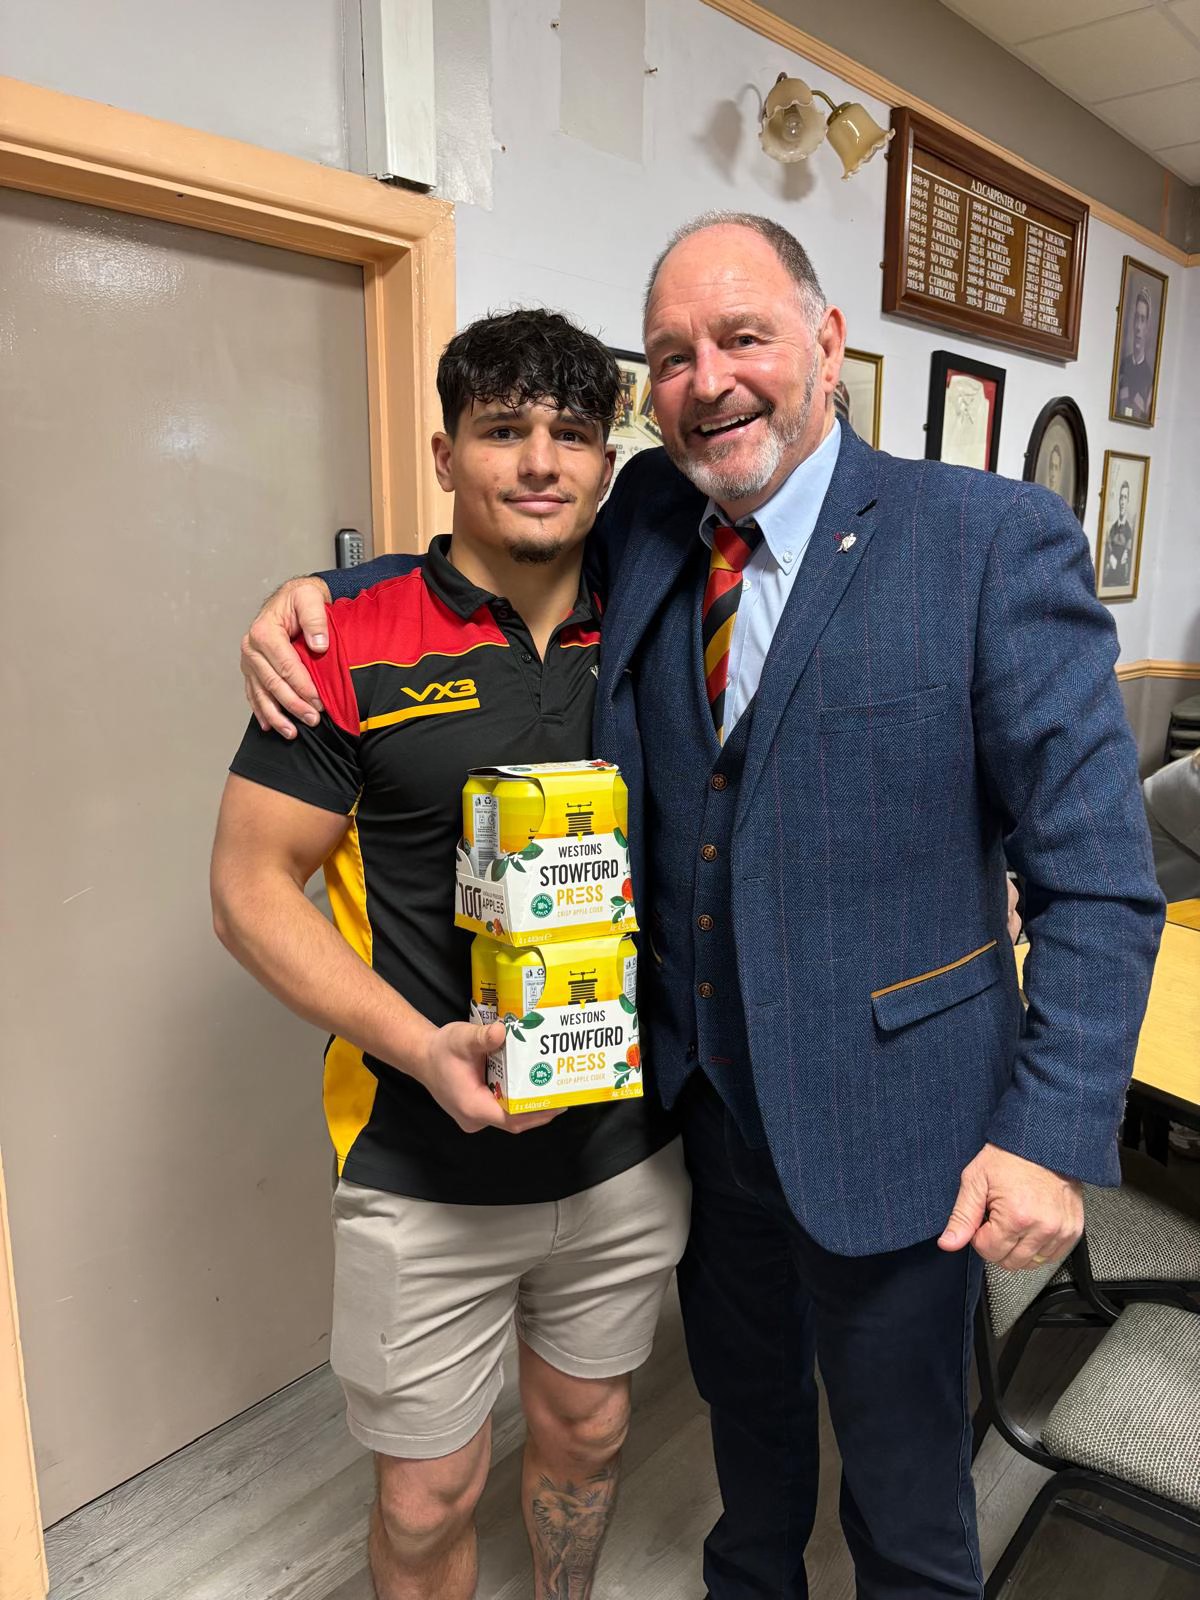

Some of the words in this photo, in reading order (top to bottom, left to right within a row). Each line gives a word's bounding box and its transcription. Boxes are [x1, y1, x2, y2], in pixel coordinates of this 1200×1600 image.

[933, 195, 959, 214] A.MARTIN
[1015, 202, 1027, 215] CUP
[939, 256, 953, 269] PRES
[400, 678, 477, 702] VX3
[558, 843, 602, 858] WESTONS
[540, 859, 619, 886] STOWFORD
[459, 882, 482, 920] 100
[557, 884, 604, 906] PRESS
[482, 897, 504, 914] APPLES
[560, 1010, 606, 1026] WESTONS
[540, 1026, 623, 1055] STOWFORD
[557, 1052, 606, 1074] PRESS
[557, 1077, 573, 1086] CRISP
[573, 1075, 588, 1083] APPLE
[589, 1073, 606, 1081] CIDER
